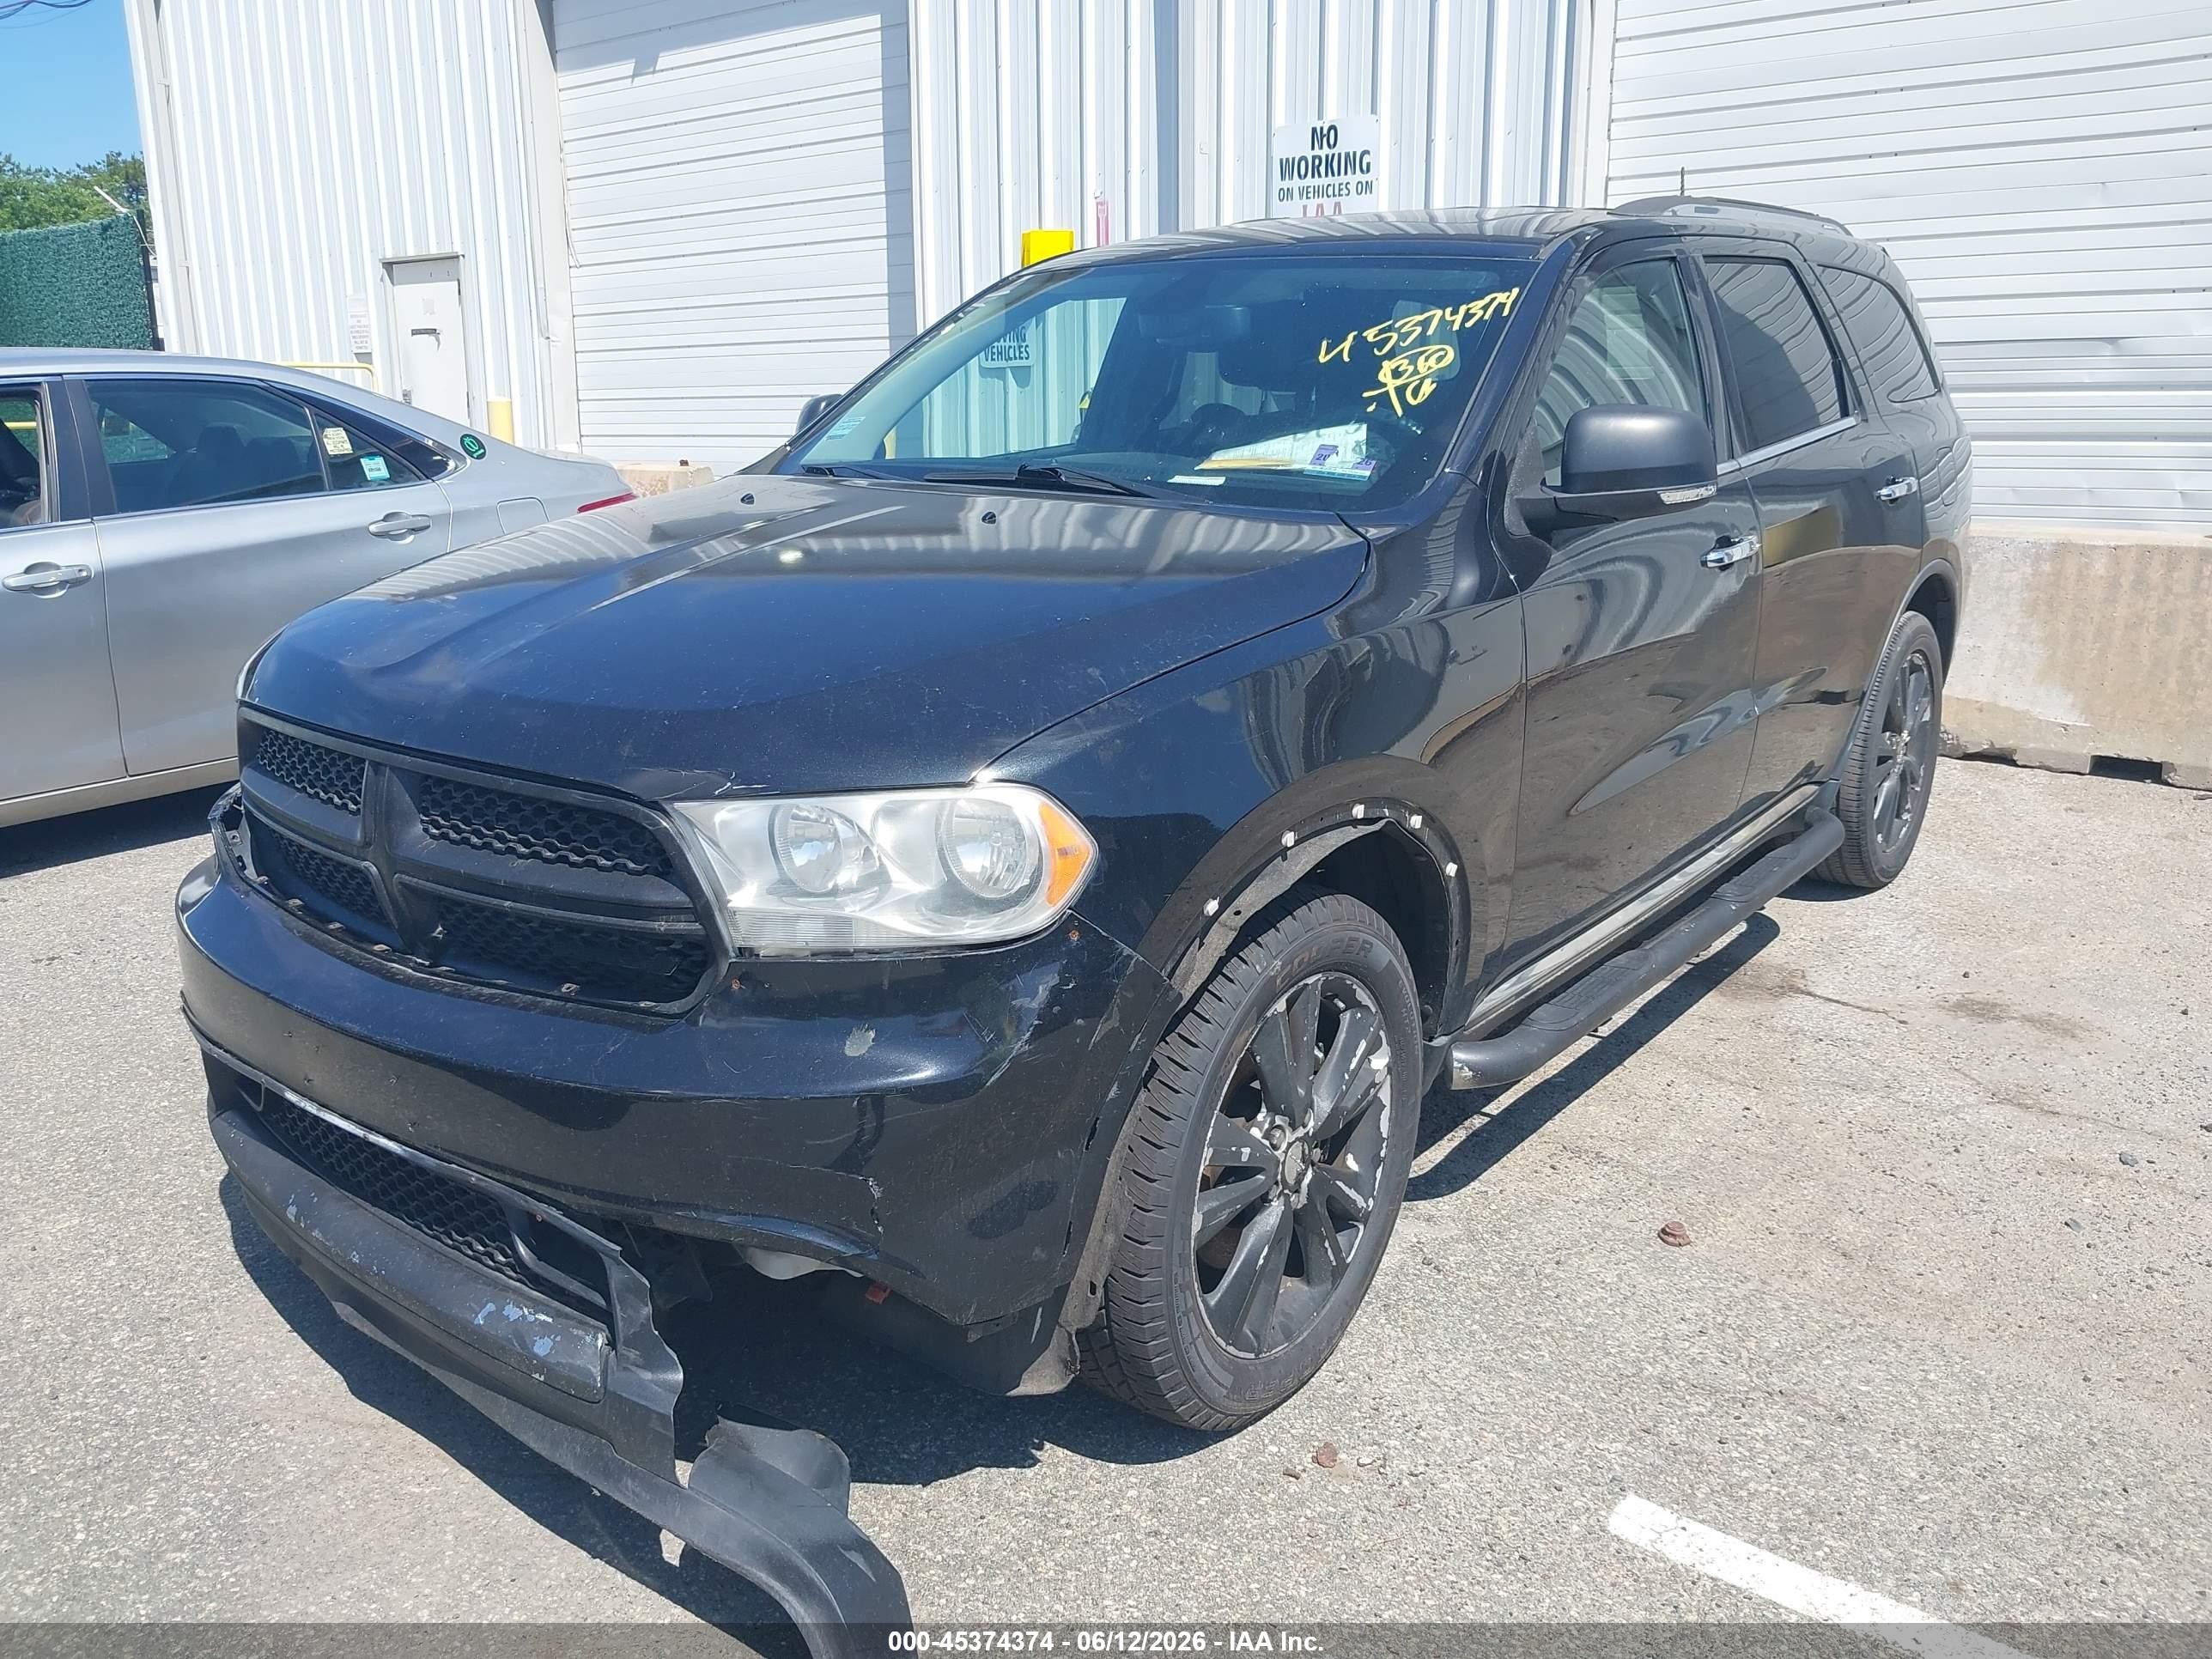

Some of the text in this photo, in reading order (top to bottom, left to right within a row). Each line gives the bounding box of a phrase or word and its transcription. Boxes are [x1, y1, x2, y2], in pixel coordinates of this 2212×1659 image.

[1311, 124, 1338, 151] NO
[1279, 149, 1371, 181] WORKING
[1278, 179, 1373, 203] ON VEHICLES ON
[984, 343, 1030, 362] VEHICLES
